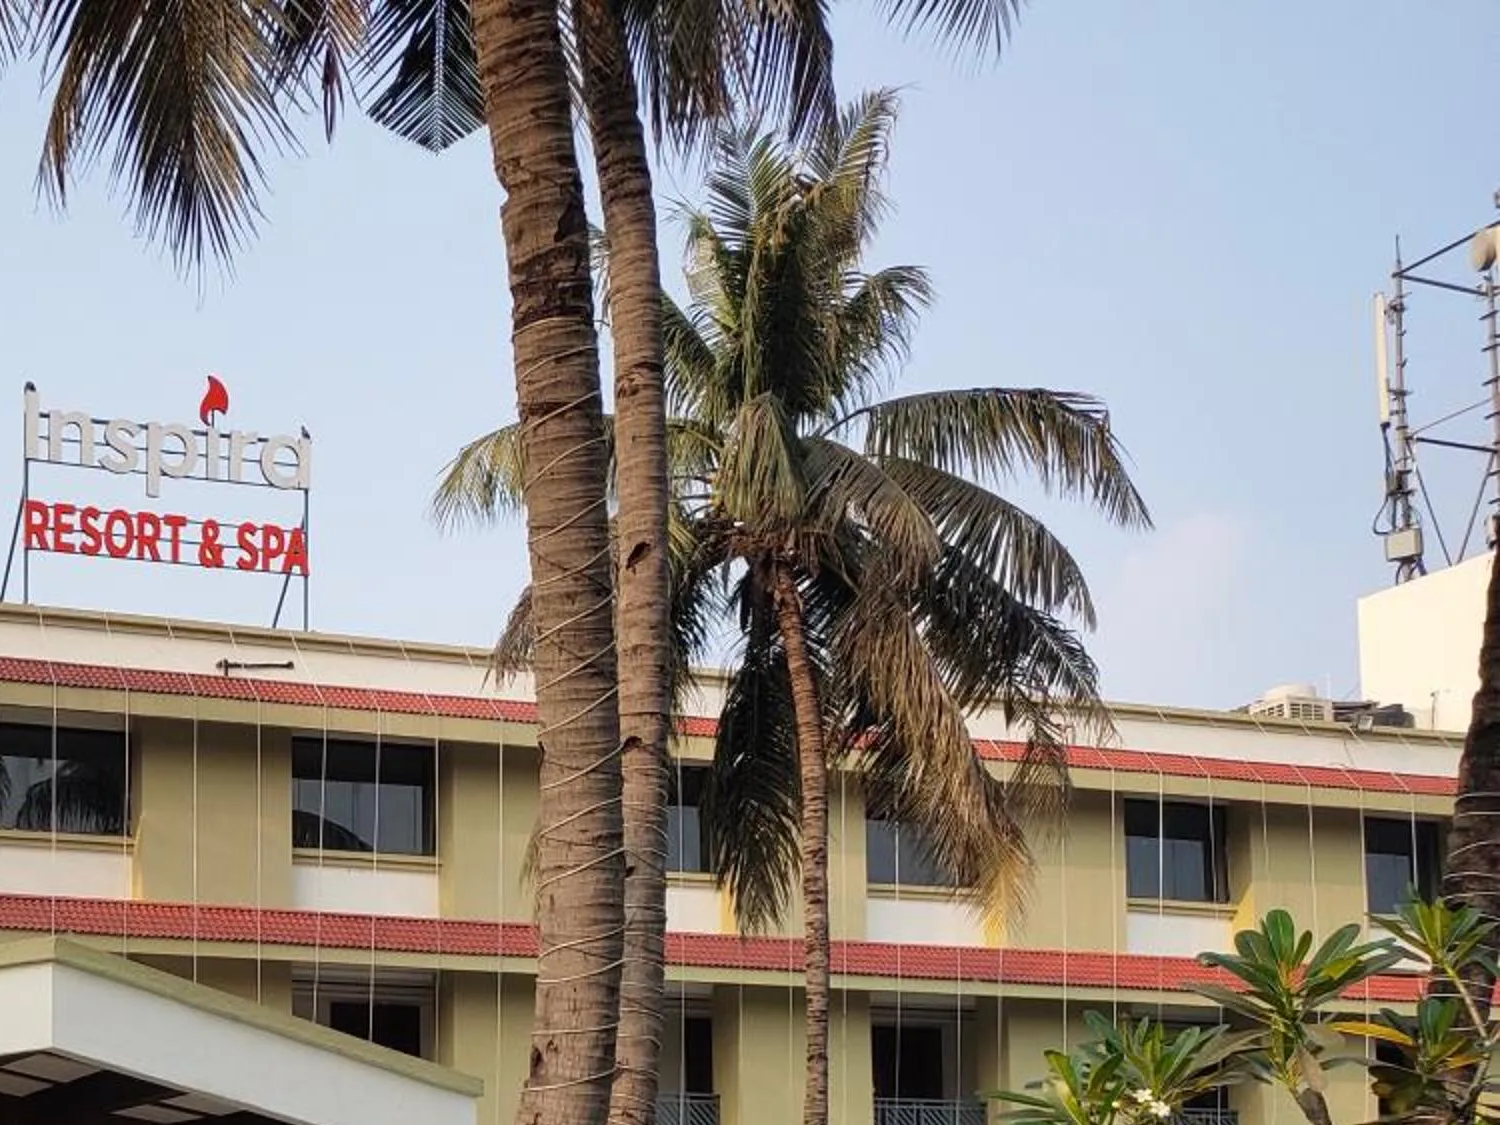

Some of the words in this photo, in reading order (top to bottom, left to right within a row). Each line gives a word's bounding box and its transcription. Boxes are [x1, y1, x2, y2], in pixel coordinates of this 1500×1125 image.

[23, 499, 187, 563] RESORT
[198, 518, 225, 569] &
[236, 522, 310, 576] SPA
